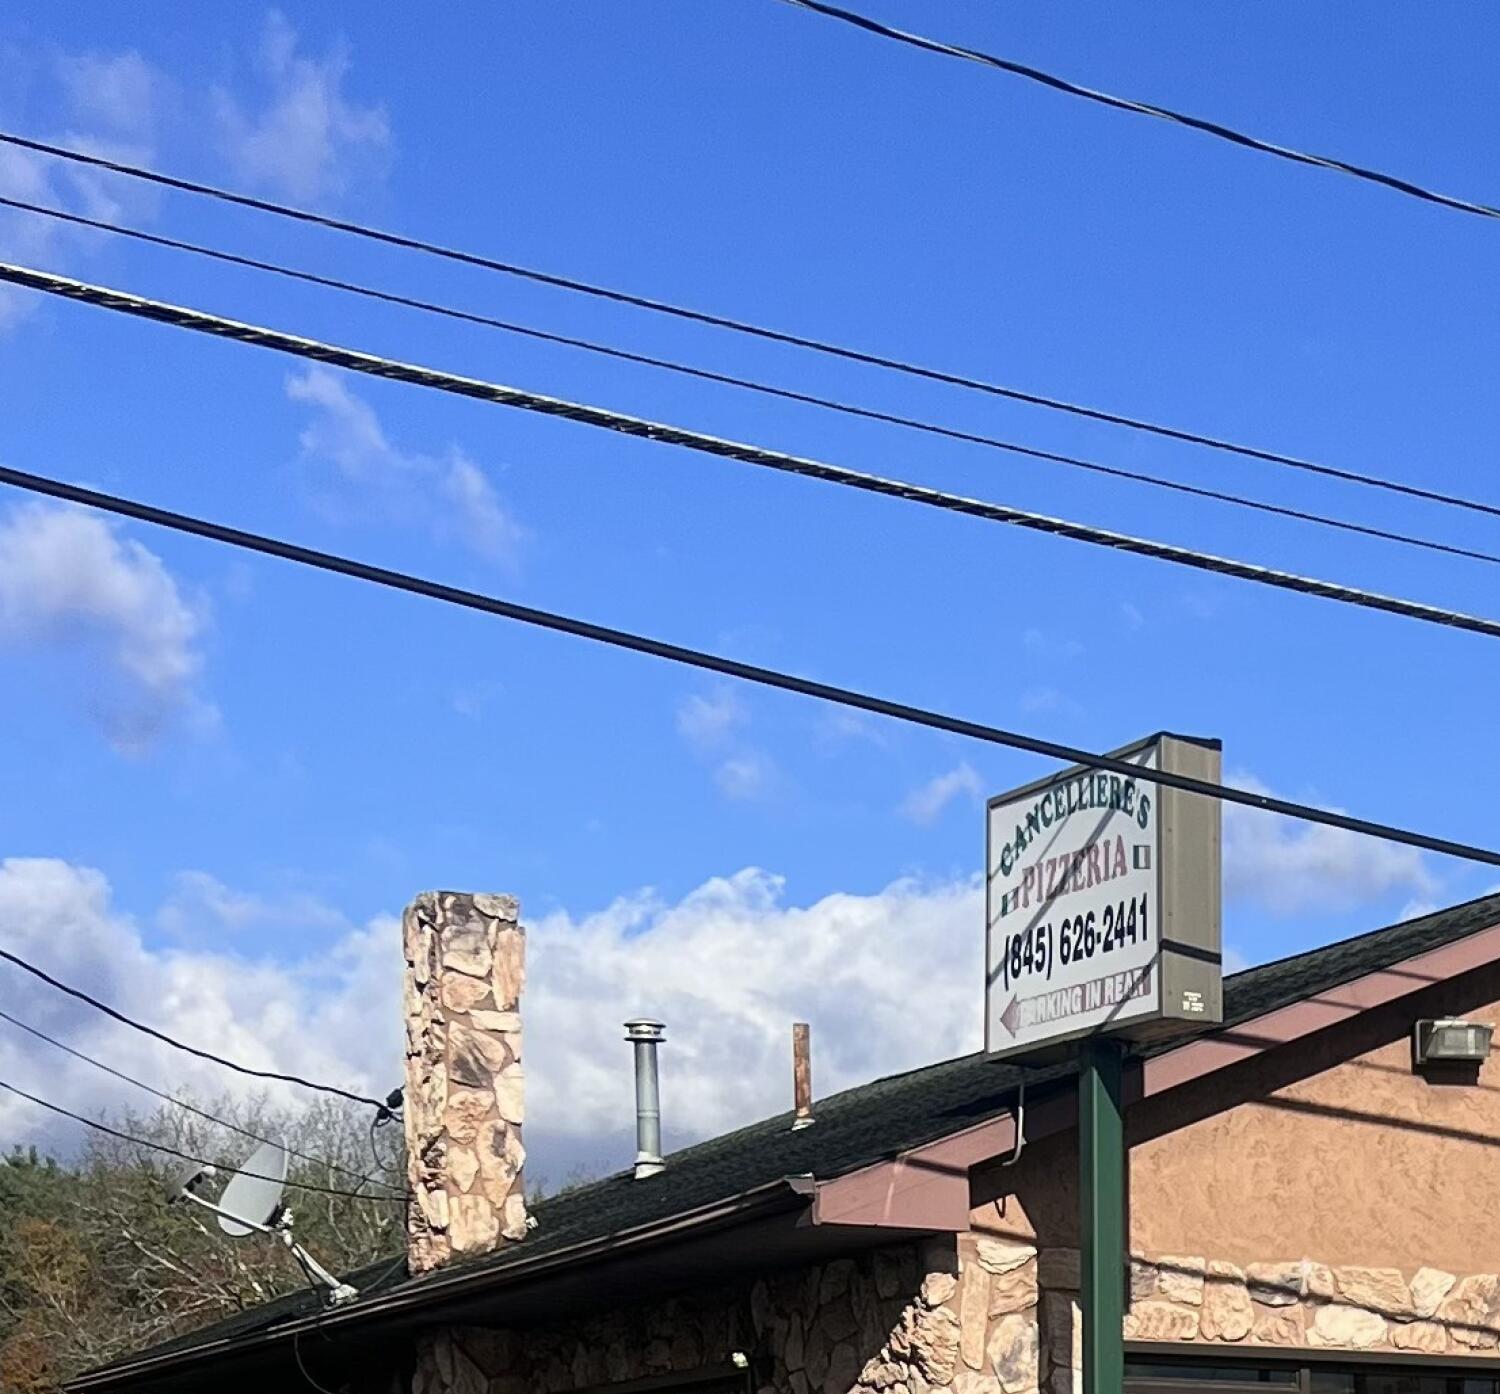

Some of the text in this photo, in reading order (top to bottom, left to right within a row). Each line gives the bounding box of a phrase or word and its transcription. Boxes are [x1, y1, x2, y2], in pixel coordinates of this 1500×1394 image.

[1000, 771, 1150, 877] CANCELLIERE'S
[1021, 834, 1128, 909] PIZZERIA
[1004, 892, 1148, 991] (845) 626-2441
[1085, 980, 1102, 1011] IN
